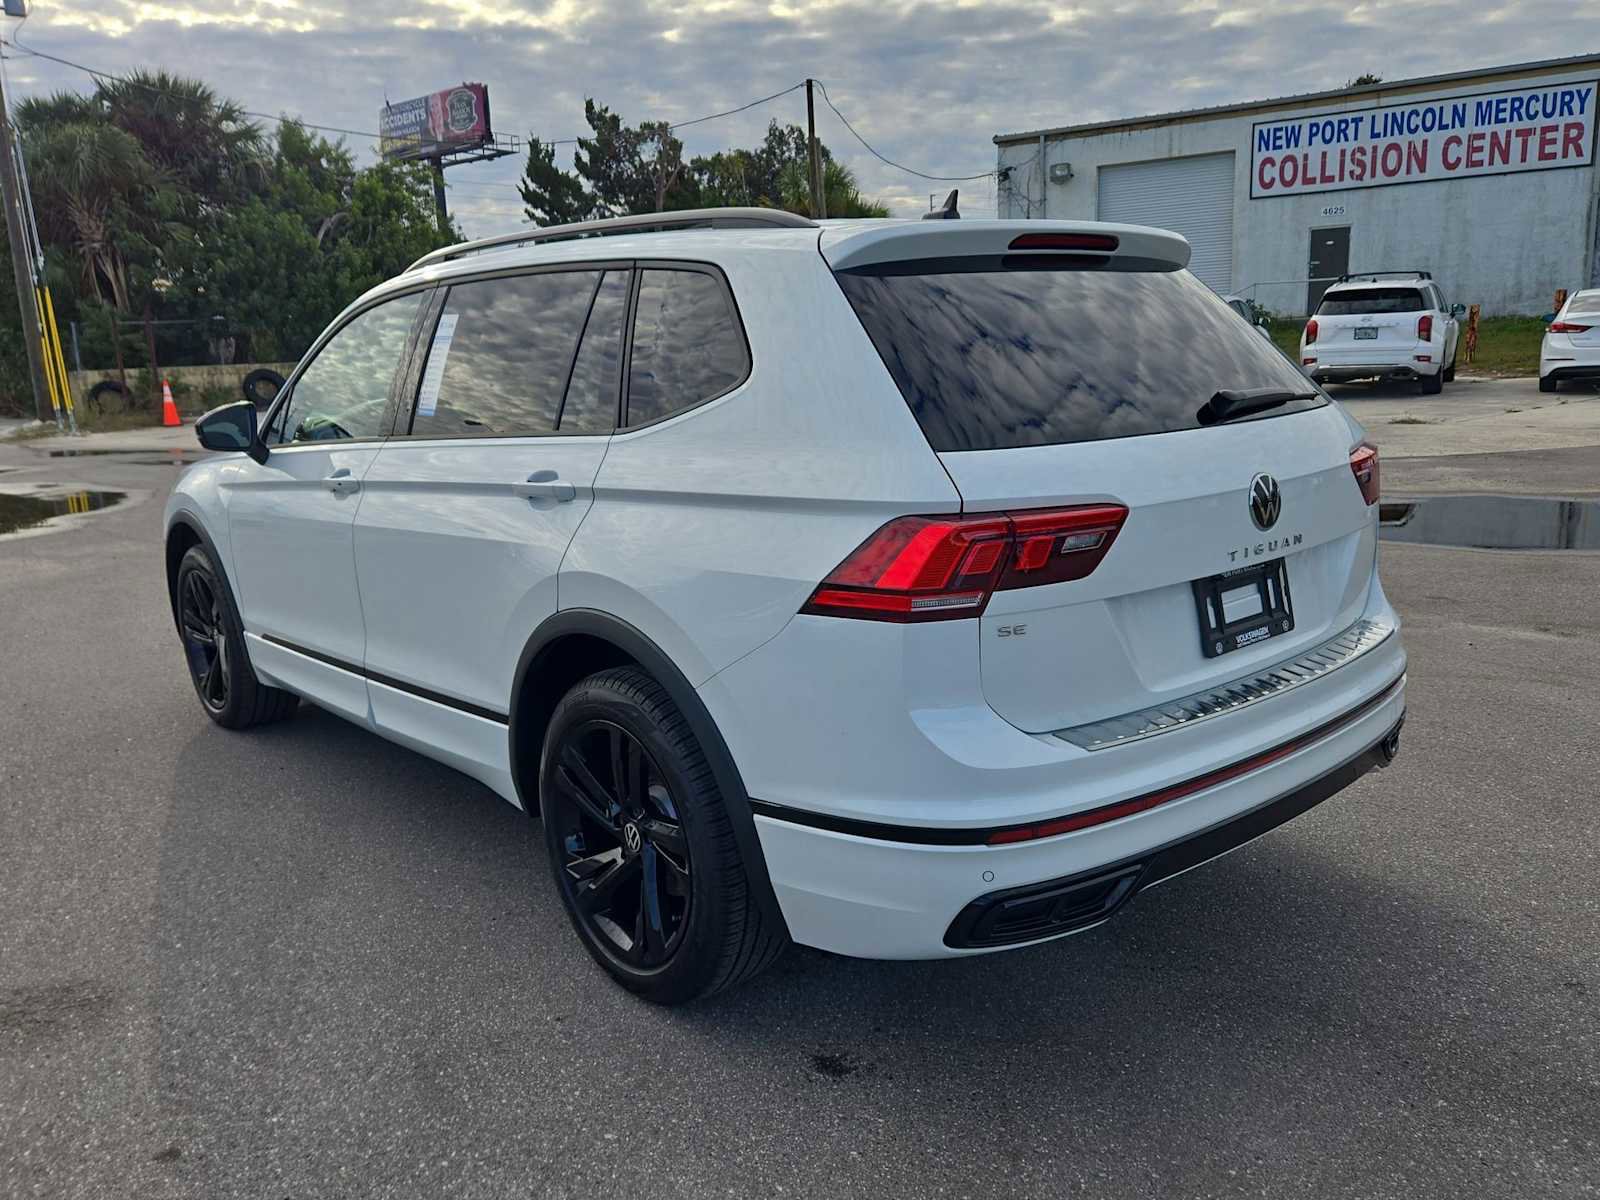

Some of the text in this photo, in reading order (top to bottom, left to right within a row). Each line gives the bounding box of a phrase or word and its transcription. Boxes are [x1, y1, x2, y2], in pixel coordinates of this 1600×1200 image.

[1258, 87, 1592, 152] NEW PORT LINCOLN MERCURY
[1258, 122, 1585, 190] COLLISION CENTER
[1227, 533, 1303, 562] TIGUAN
[997, 624, 1027, 637] SE
